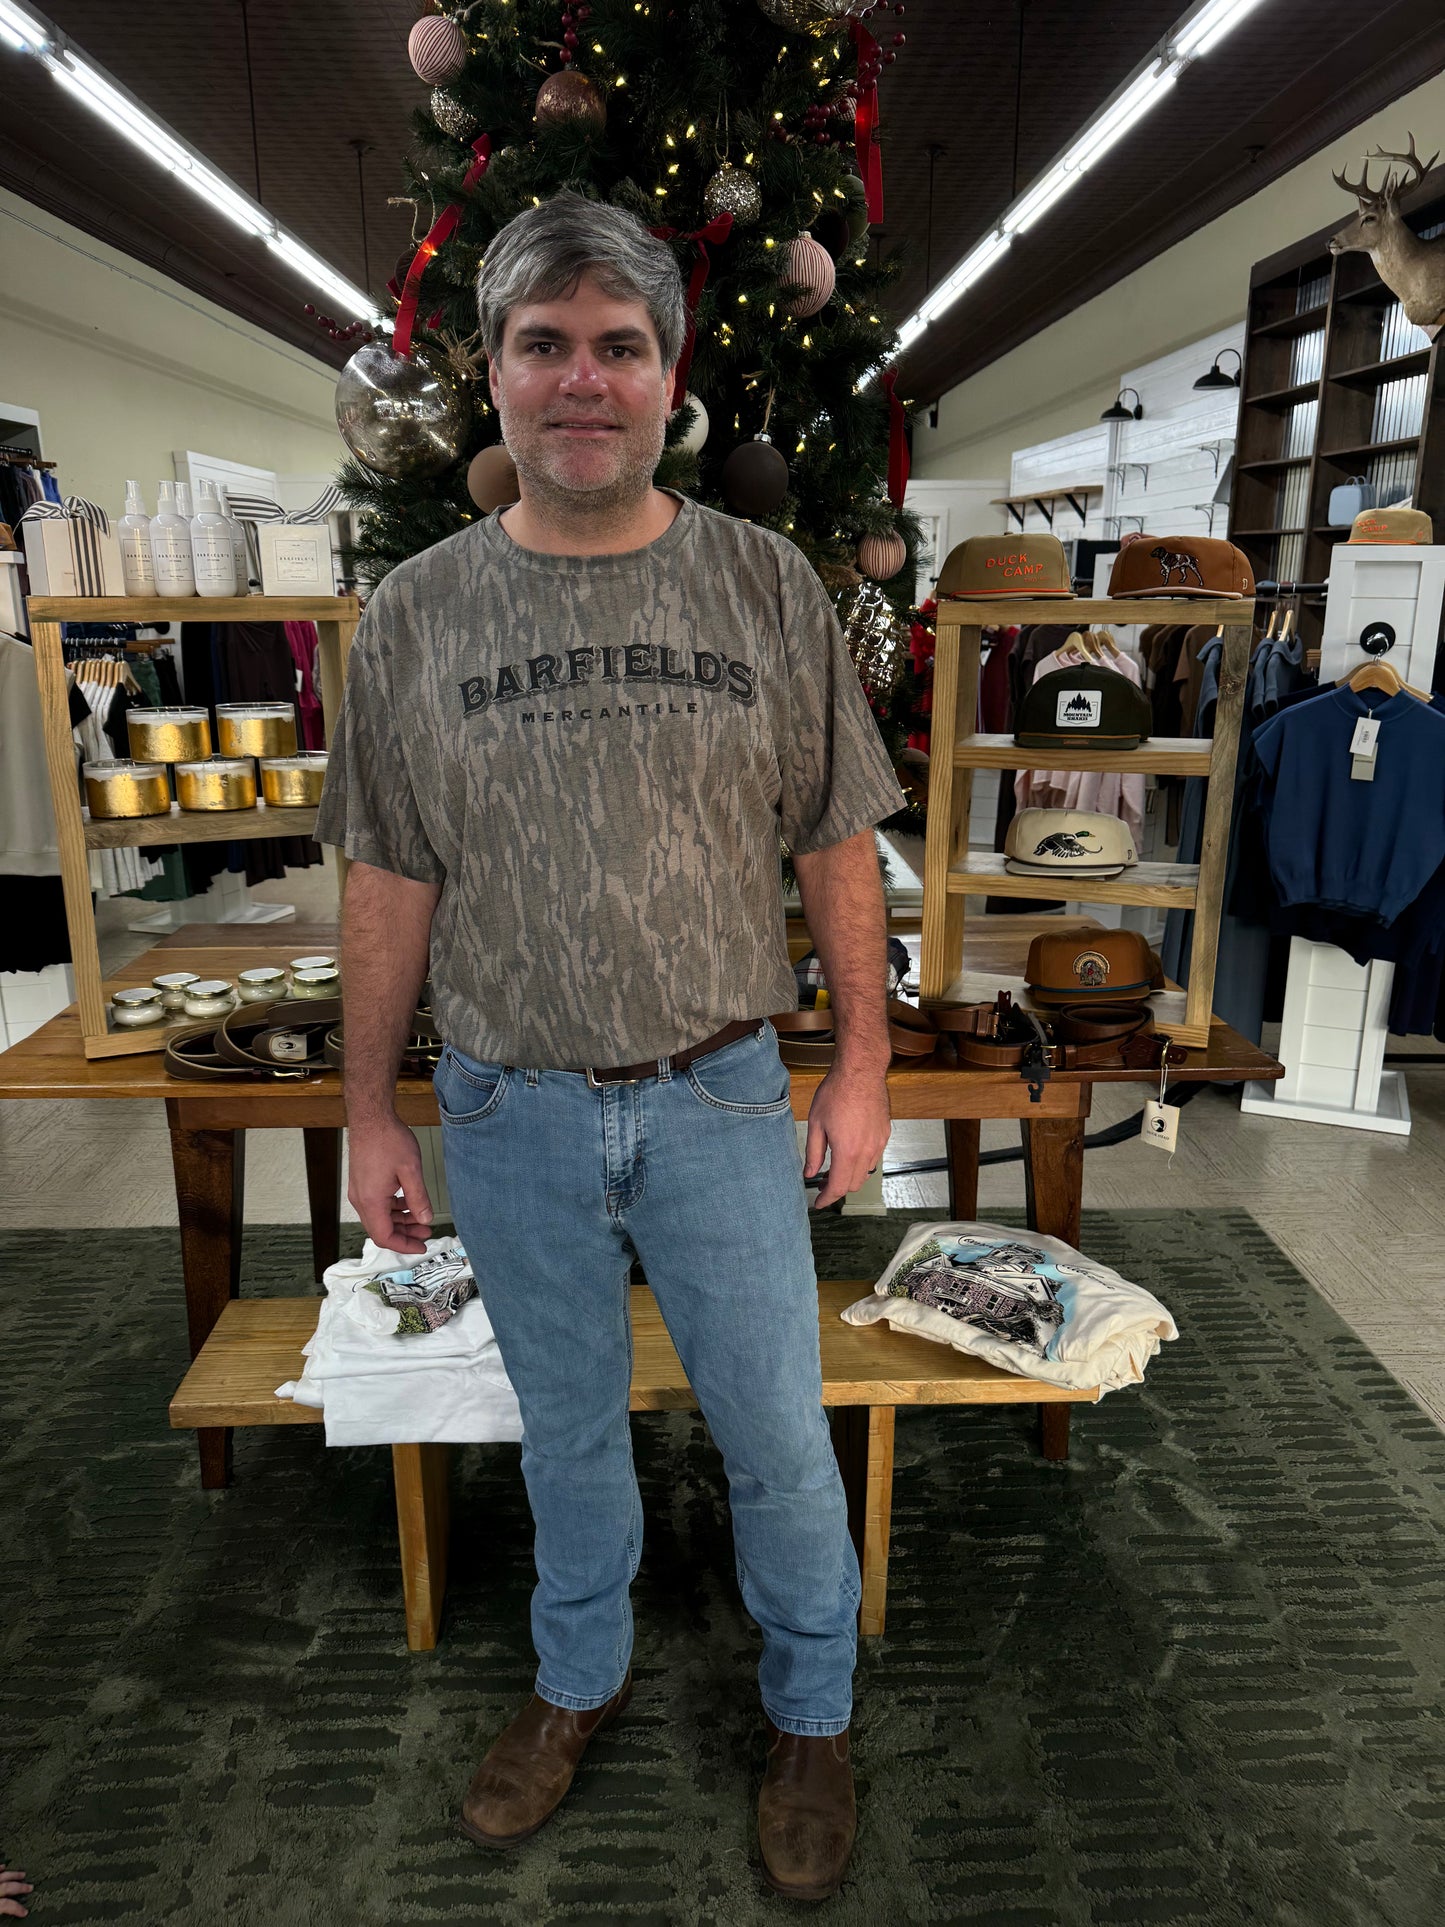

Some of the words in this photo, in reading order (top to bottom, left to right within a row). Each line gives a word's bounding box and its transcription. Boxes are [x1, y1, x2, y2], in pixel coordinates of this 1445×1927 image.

[985, 552, 1027, 569] DUCK
[1003, 563, 1044, 578] CAMP
[457, 643, 758, 718] BARFIELD'S
[521, 702, 699, 724] MERCANTILE
